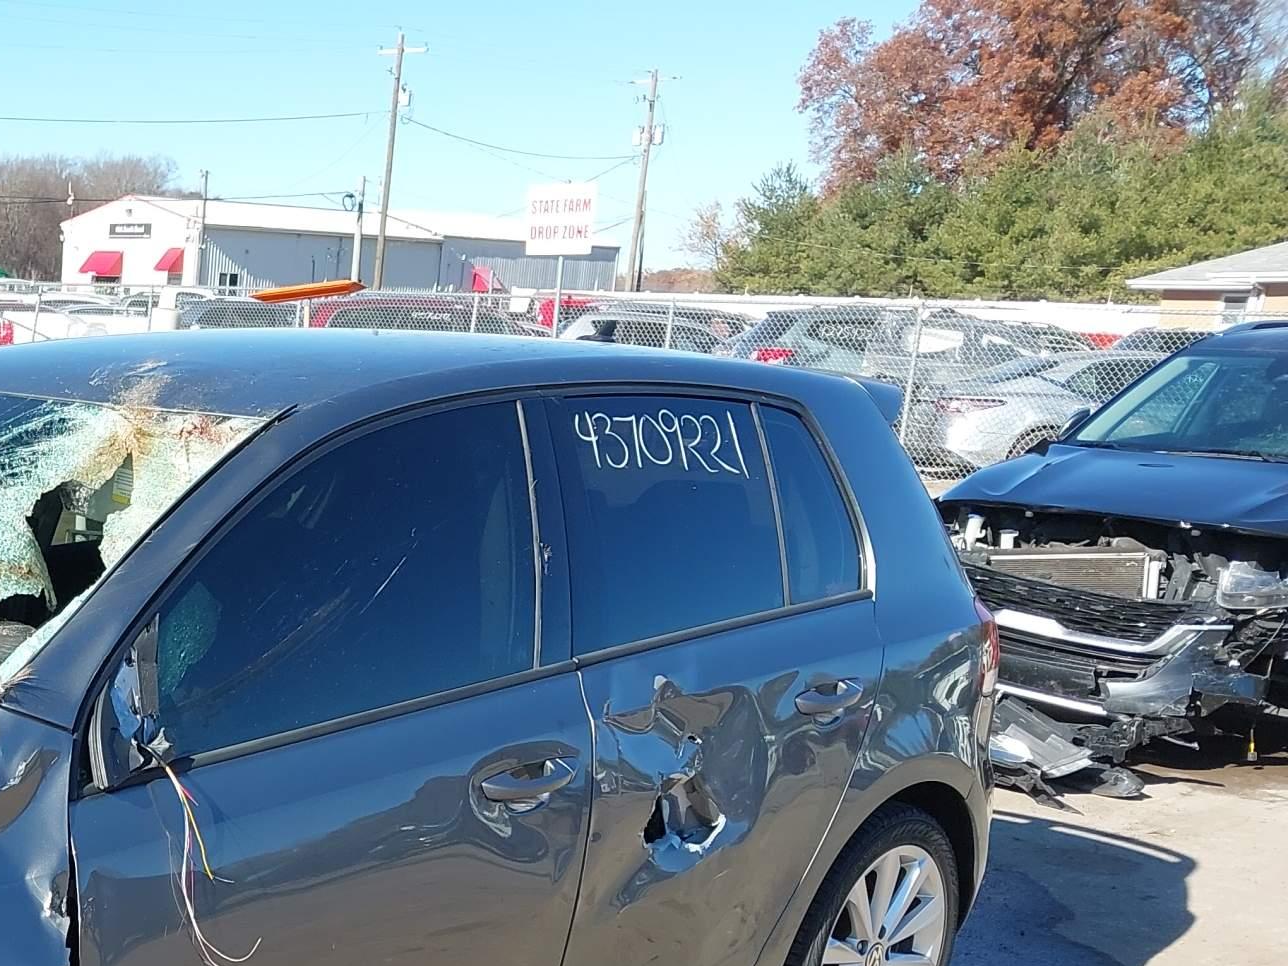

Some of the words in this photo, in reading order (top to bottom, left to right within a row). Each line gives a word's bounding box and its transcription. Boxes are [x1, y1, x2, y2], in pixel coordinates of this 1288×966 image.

[531, 200, 561, 215] STATE
[563, 198, 592, 214] FARM
[530, 226, 559, 240] DROP
[562, 224, 590, 239] ZONE
[574, 409, 750, 480] 43709221
